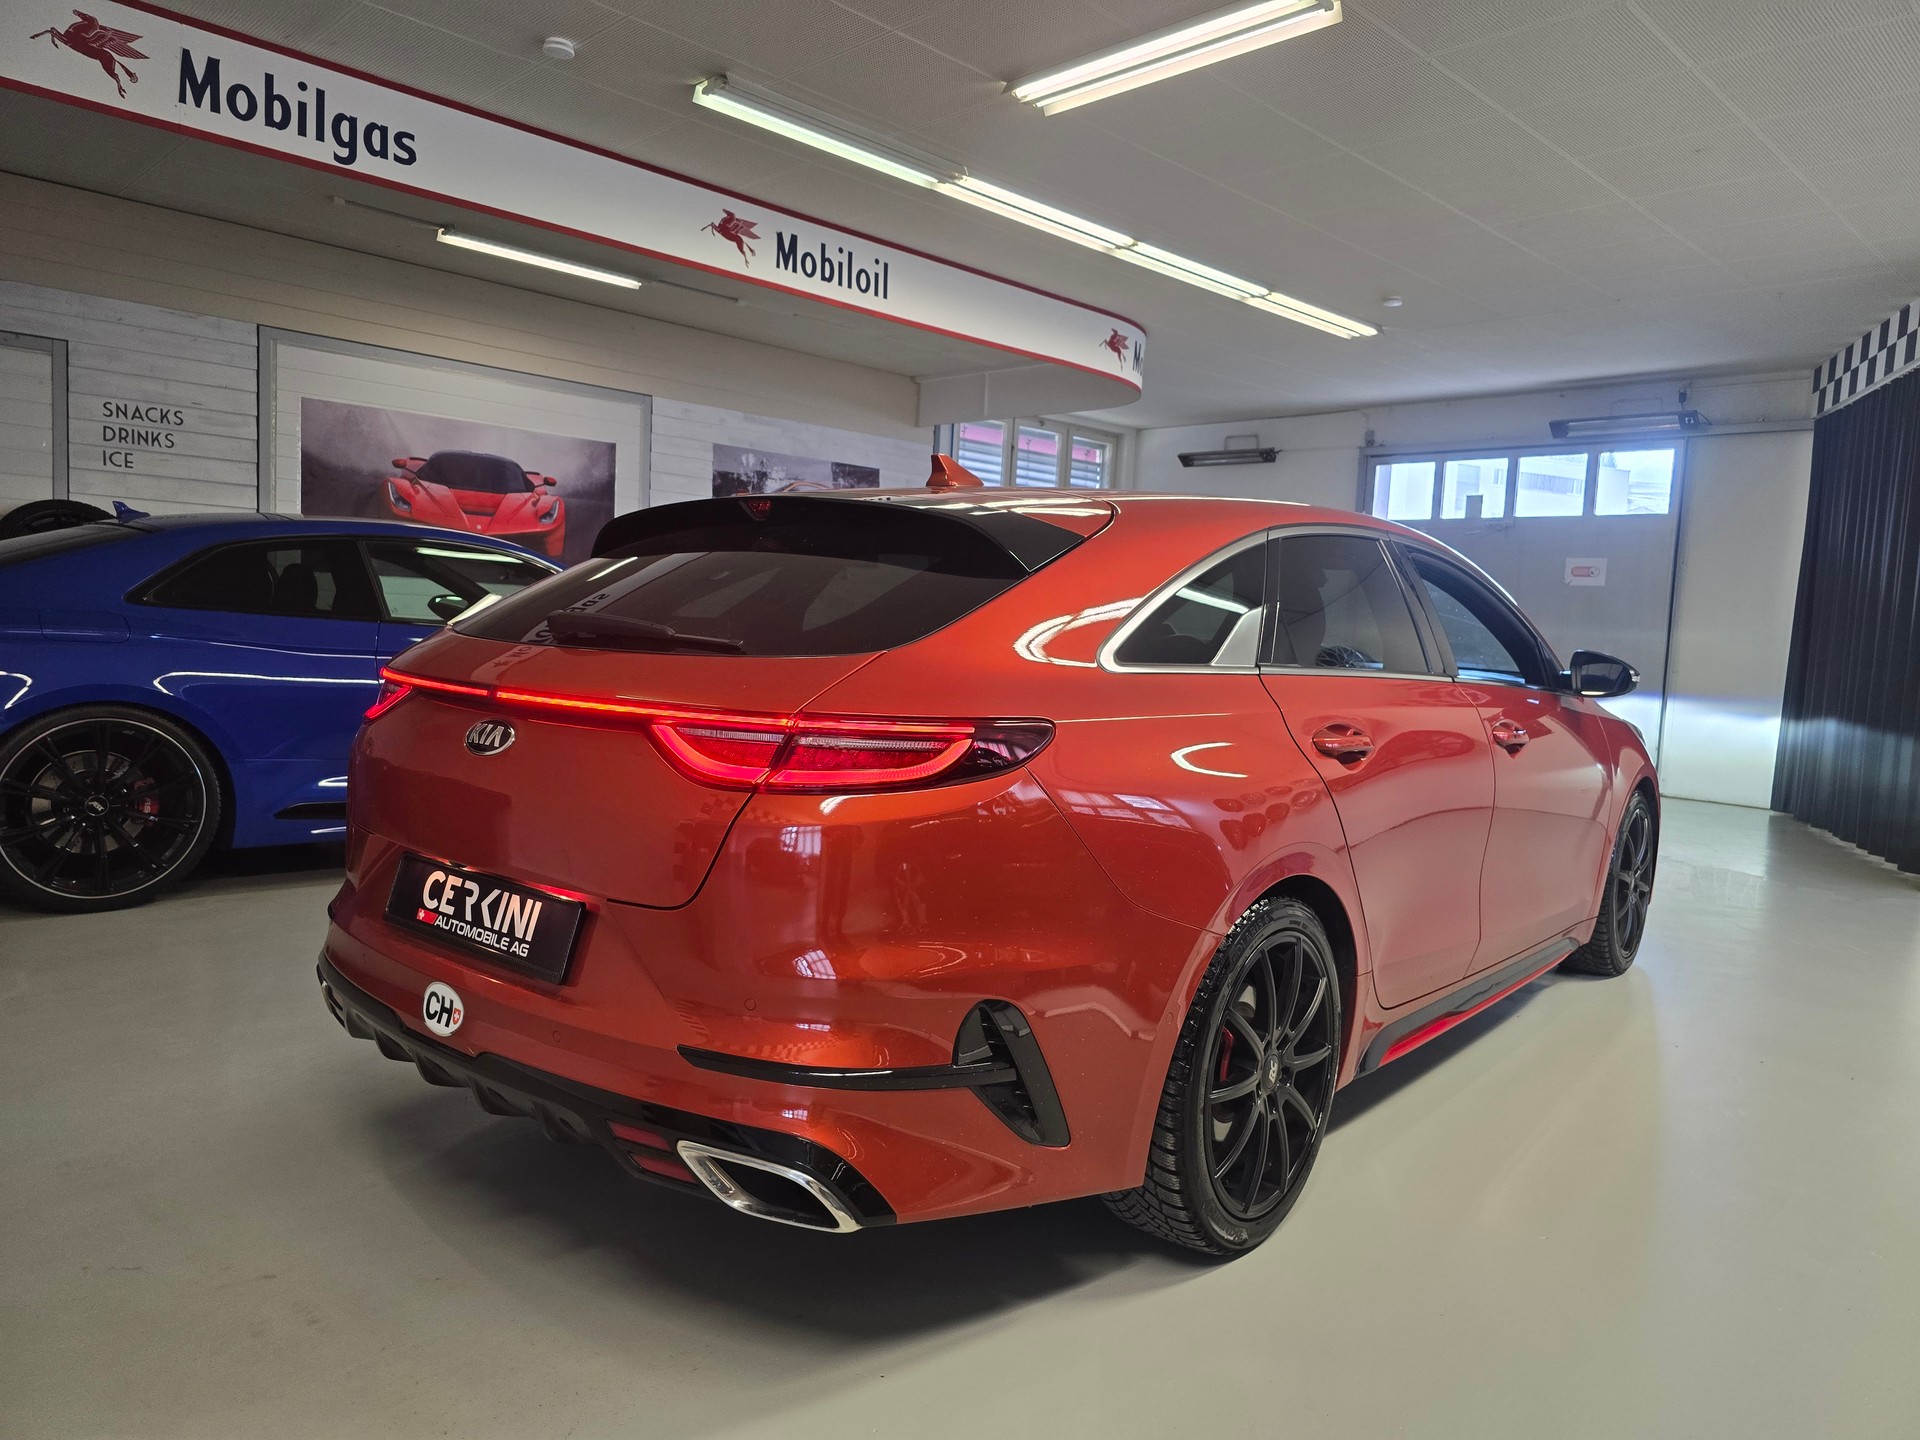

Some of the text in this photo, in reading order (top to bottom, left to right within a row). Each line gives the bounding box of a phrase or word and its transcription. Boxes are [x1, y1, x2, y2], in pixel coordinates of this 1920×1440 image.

[178, 47, 417, 166] Mobilgas
[776, 231, 889, 300] Mobiloil
[102, 401, 184, 426] SNACKS
[102, 425, 175, 449] DRINKS
[102, 450, 134, 469] ICE
[468, 723, 505, 748] KIA
[422, 870, 543, 942] CERKINI
[434, 915, 530, 958] AUTOMOBILE AG
[425, 991, 454, 1028] CH
